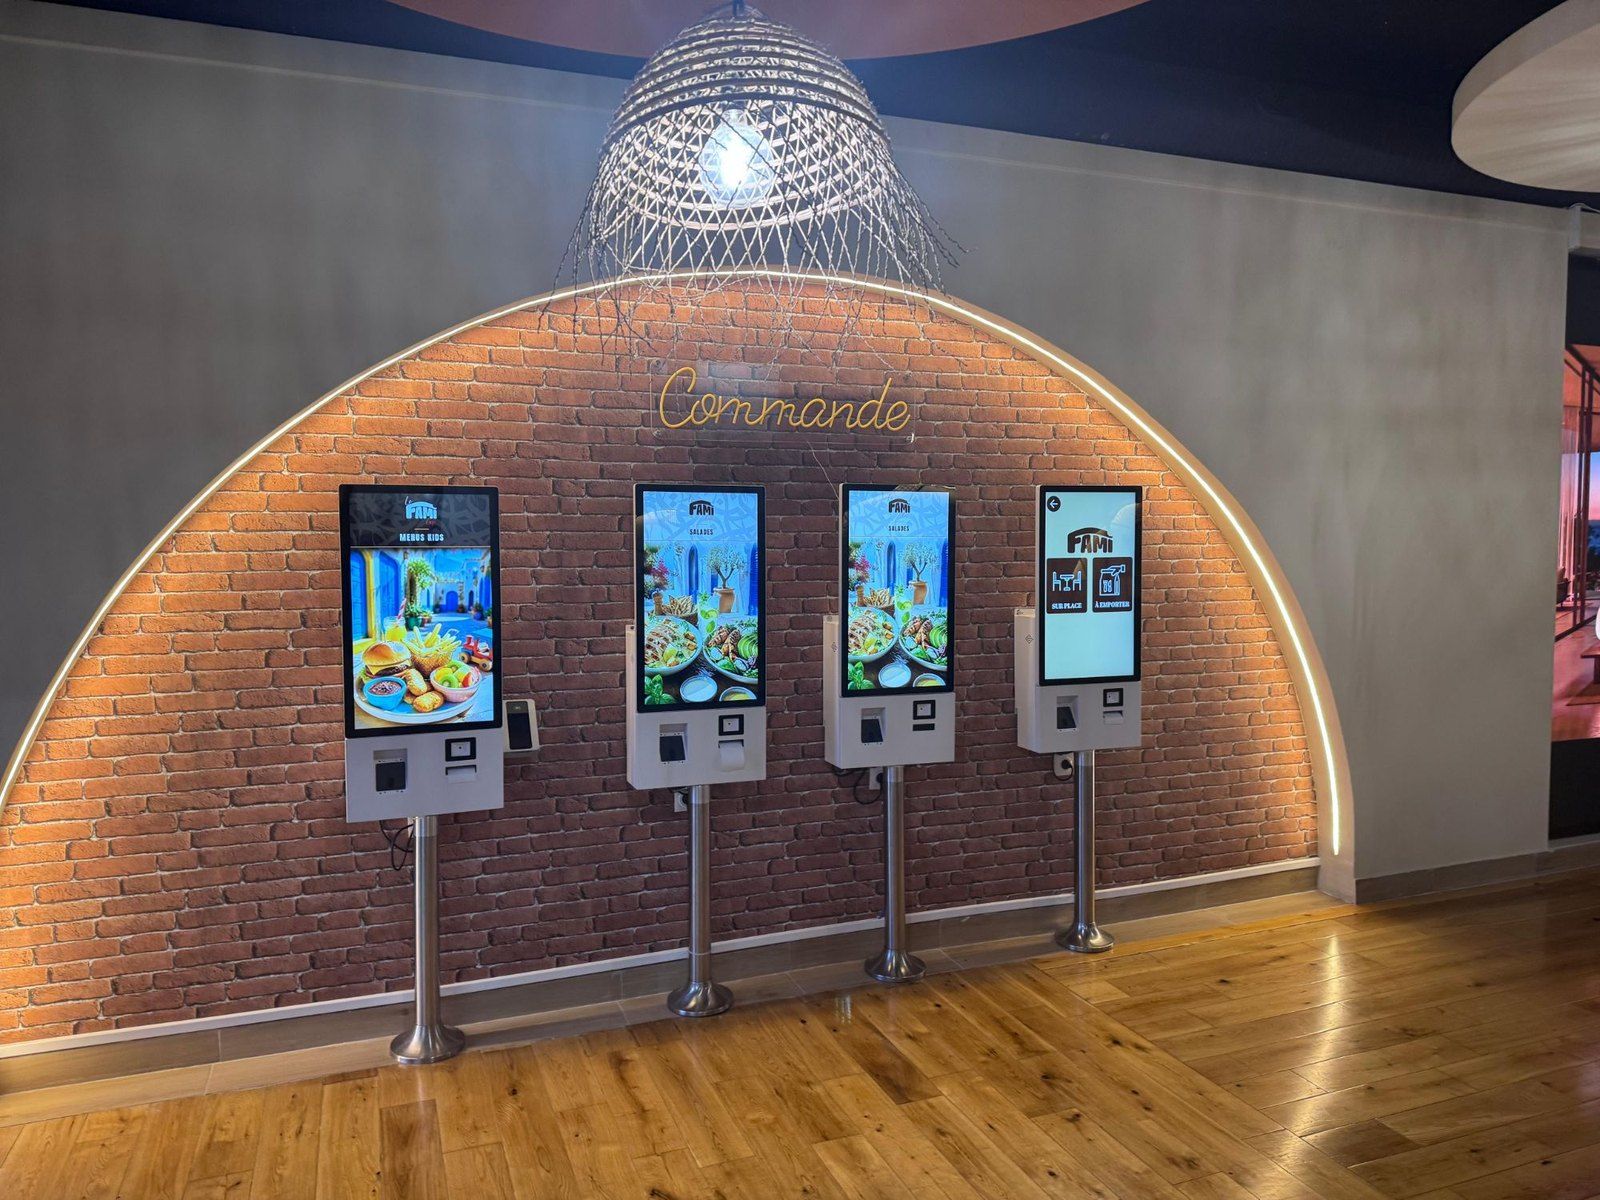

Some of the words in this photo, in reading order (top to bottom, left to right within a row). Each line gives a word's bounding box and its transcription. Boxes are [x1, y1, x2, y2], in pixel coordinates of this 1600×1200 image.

[660, 366, 911, 431] Commande
[689, 528, 714, 536] SALADES
[399, 533, 426, 542] MENUS
[427, 533, 445, 542] KIDS
